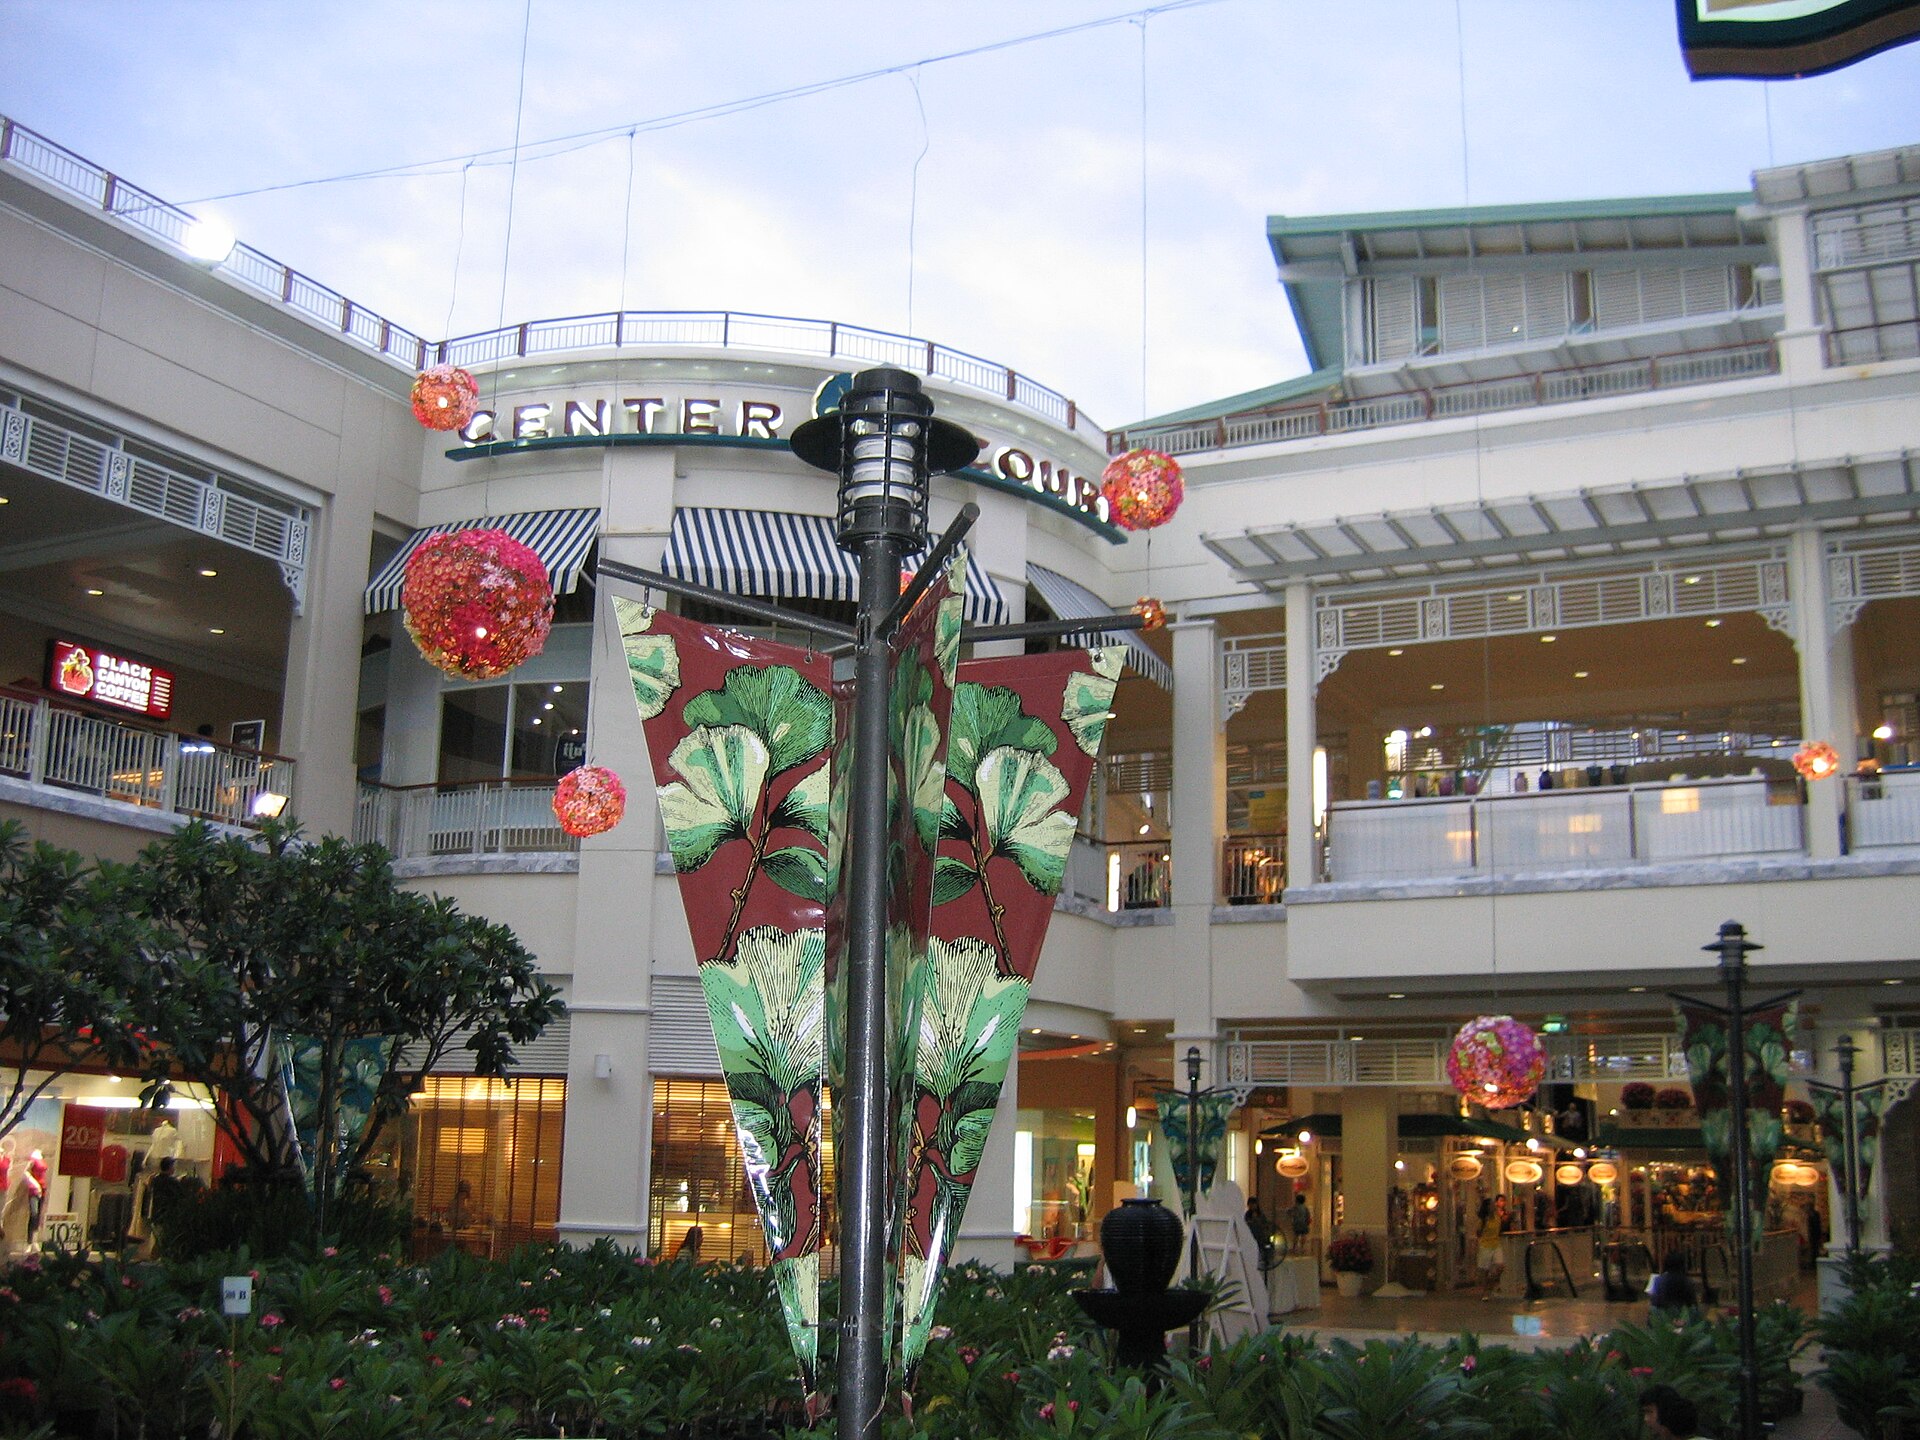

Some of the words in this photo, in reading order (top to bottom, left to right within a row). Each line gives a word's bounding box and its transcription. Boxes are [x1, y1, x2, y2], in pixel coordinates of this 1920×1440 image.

[459, 397, 785, 448] CENTER
[970, 437, 1110, 524] OUR
[99, 654, 152, 680] BLACK
[97, 668, 151, 693] CANYON
[96, 681, 149, 706] COFFEE
